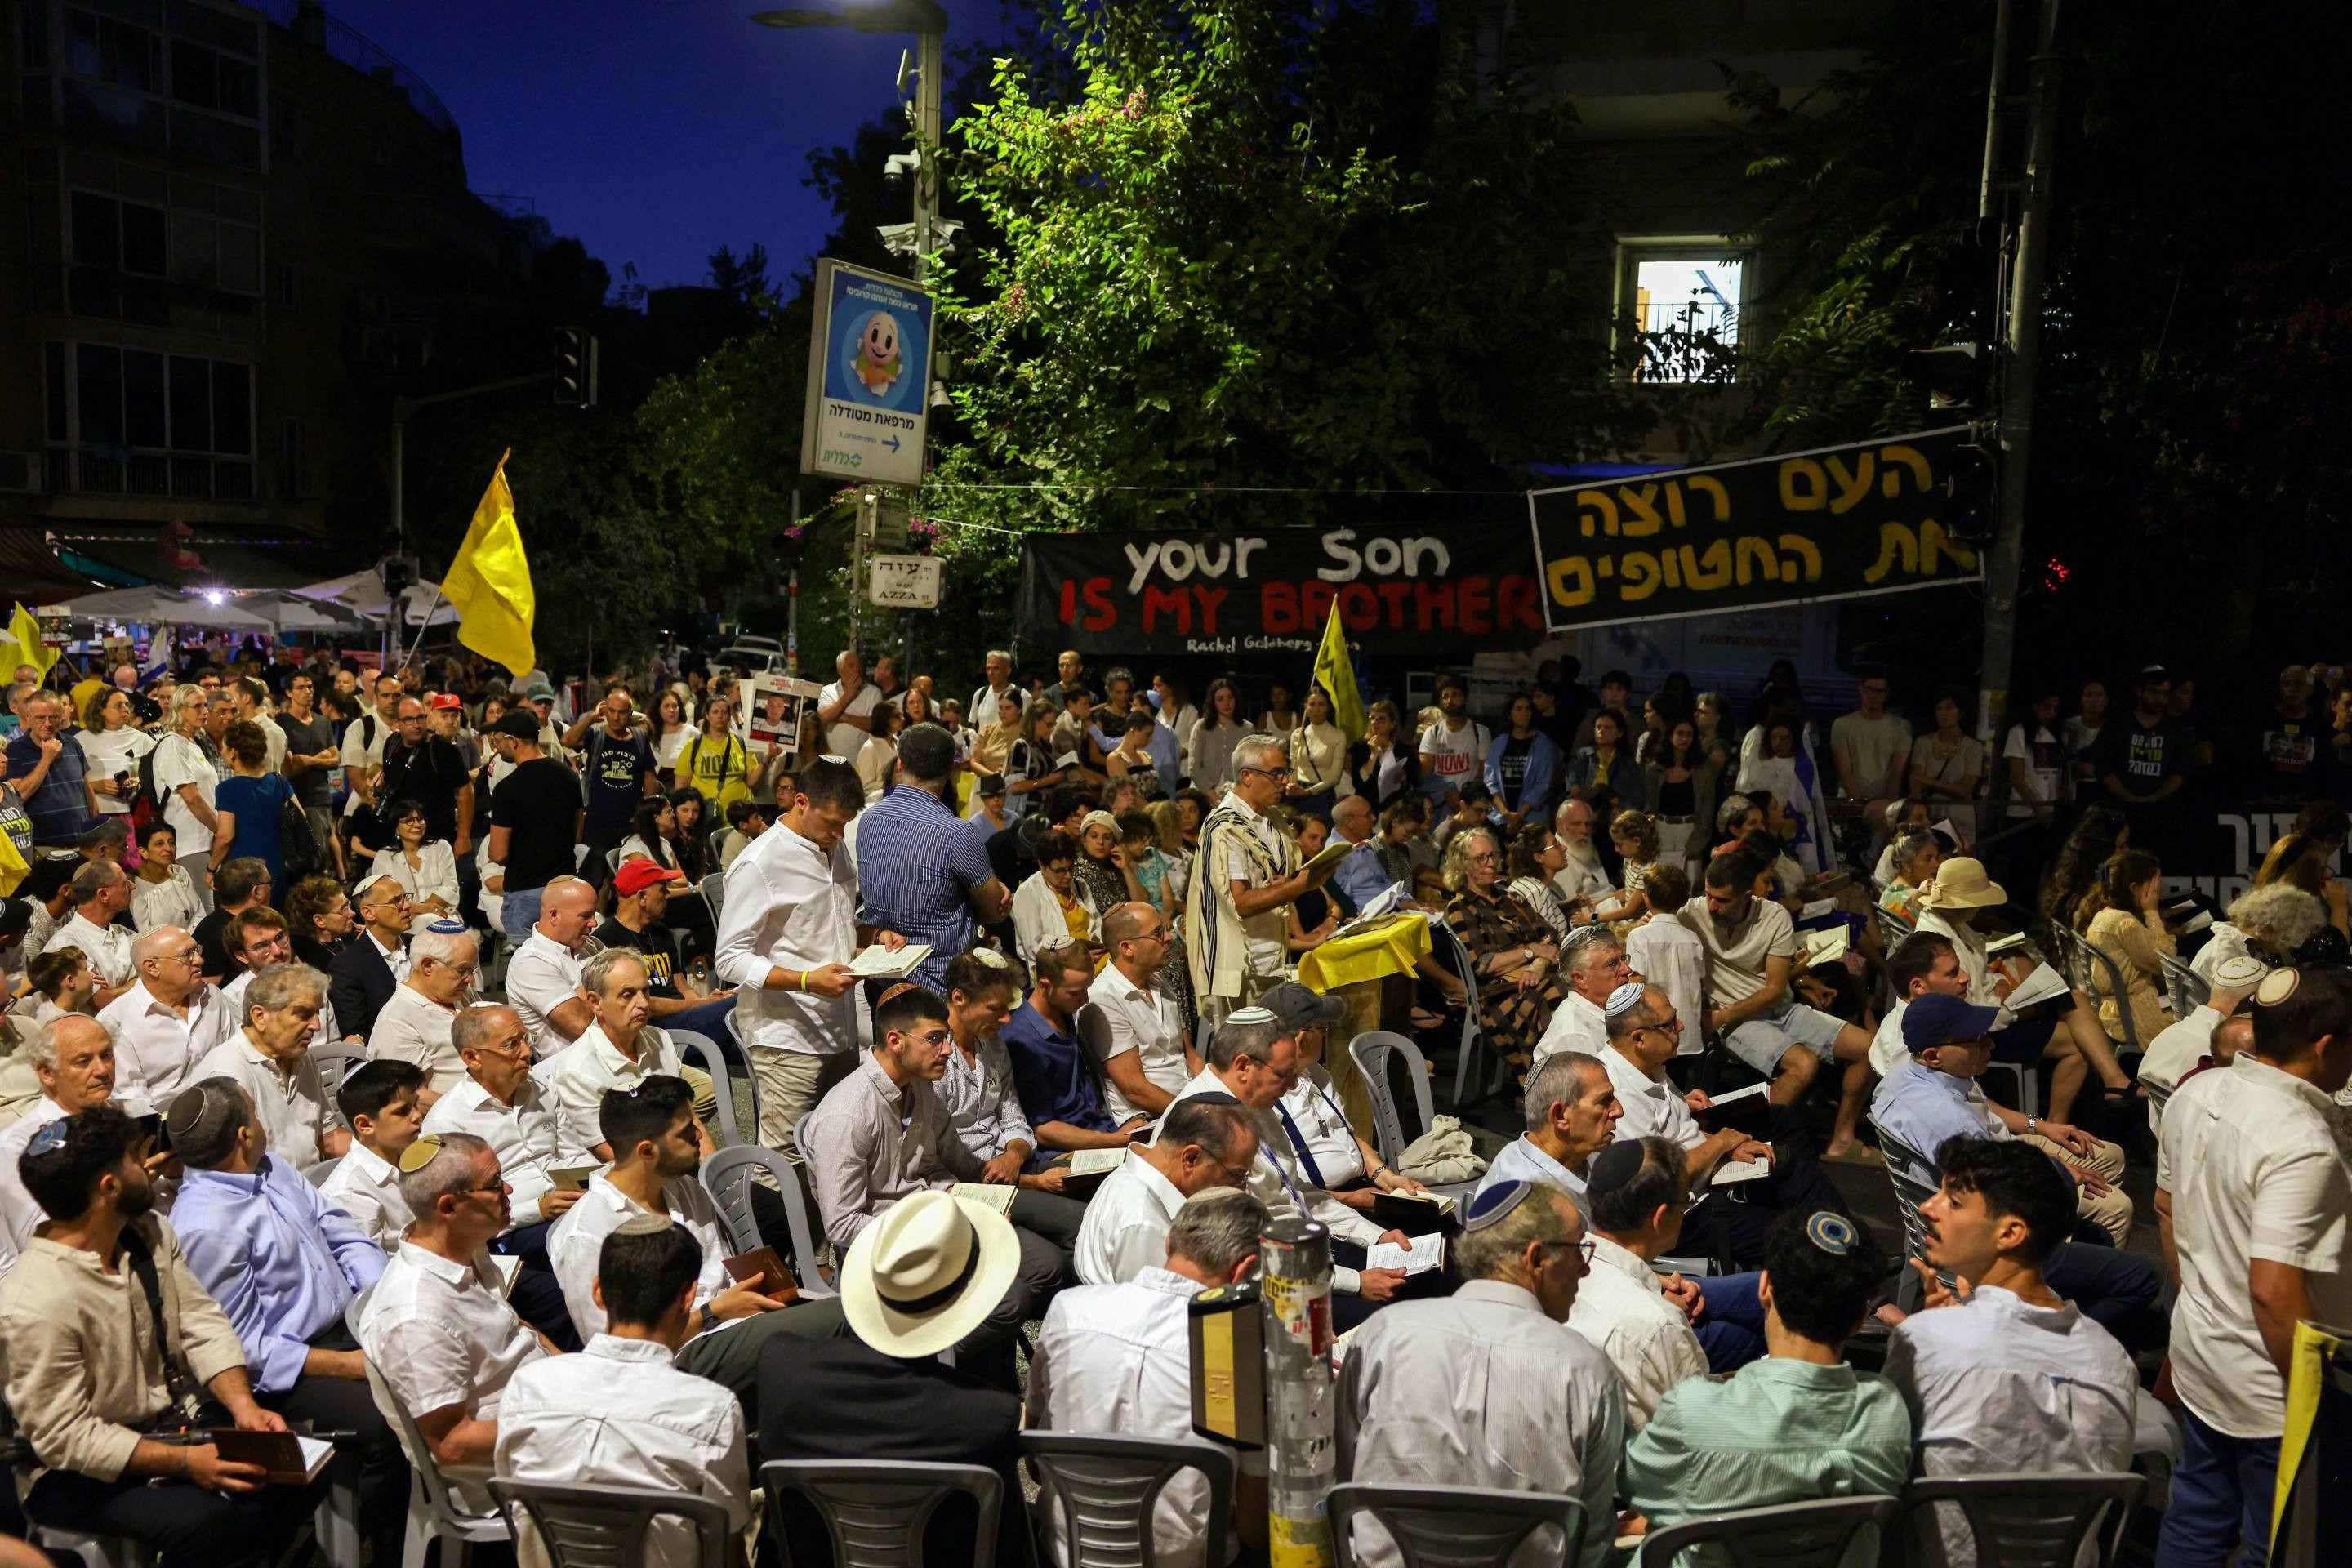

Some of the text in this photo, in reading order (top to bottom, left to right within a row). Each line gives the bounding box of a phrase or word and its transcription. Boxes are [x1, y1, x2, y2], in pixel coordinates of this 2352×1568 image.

[829, 403, 915, 430] מרפאת מטודלה
[822, 449, 849, 464] כללית
[1576, 445, 1933, 538] העם רוצה
[1317, 525, 1451, 582] Son
[1547, 518, 1978, 608] את החטופים
[880, 562, 920, 575] עזה
[879, 590, 917, 600] AZZA
[1059, 574, 1543, 636] IS MY BROTHER
[1437, 752, 1471, 772] NOW!
